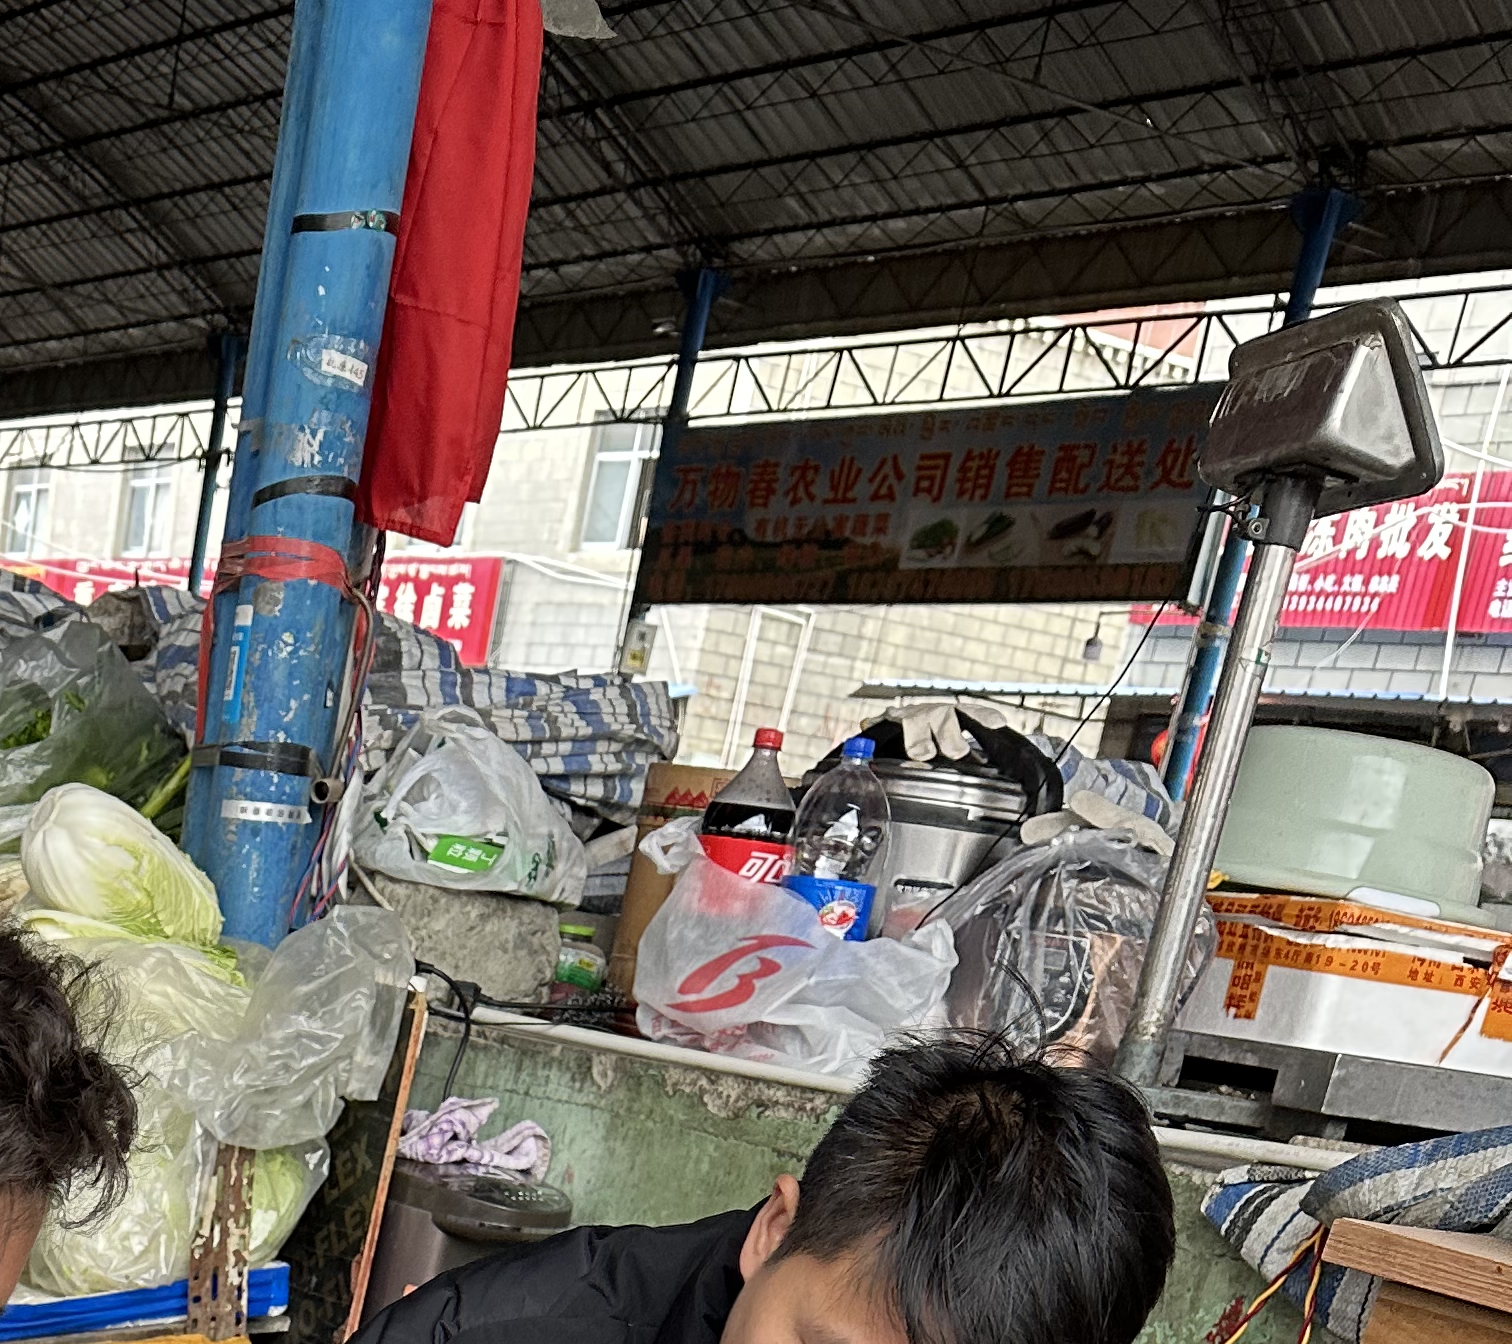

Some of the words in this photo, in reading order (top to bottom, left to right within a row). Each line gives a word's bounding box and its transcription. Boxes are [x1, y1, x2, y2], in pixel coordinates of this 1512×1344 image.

[668, 435, 1195, 513] 万物春农业公司销售配送处
